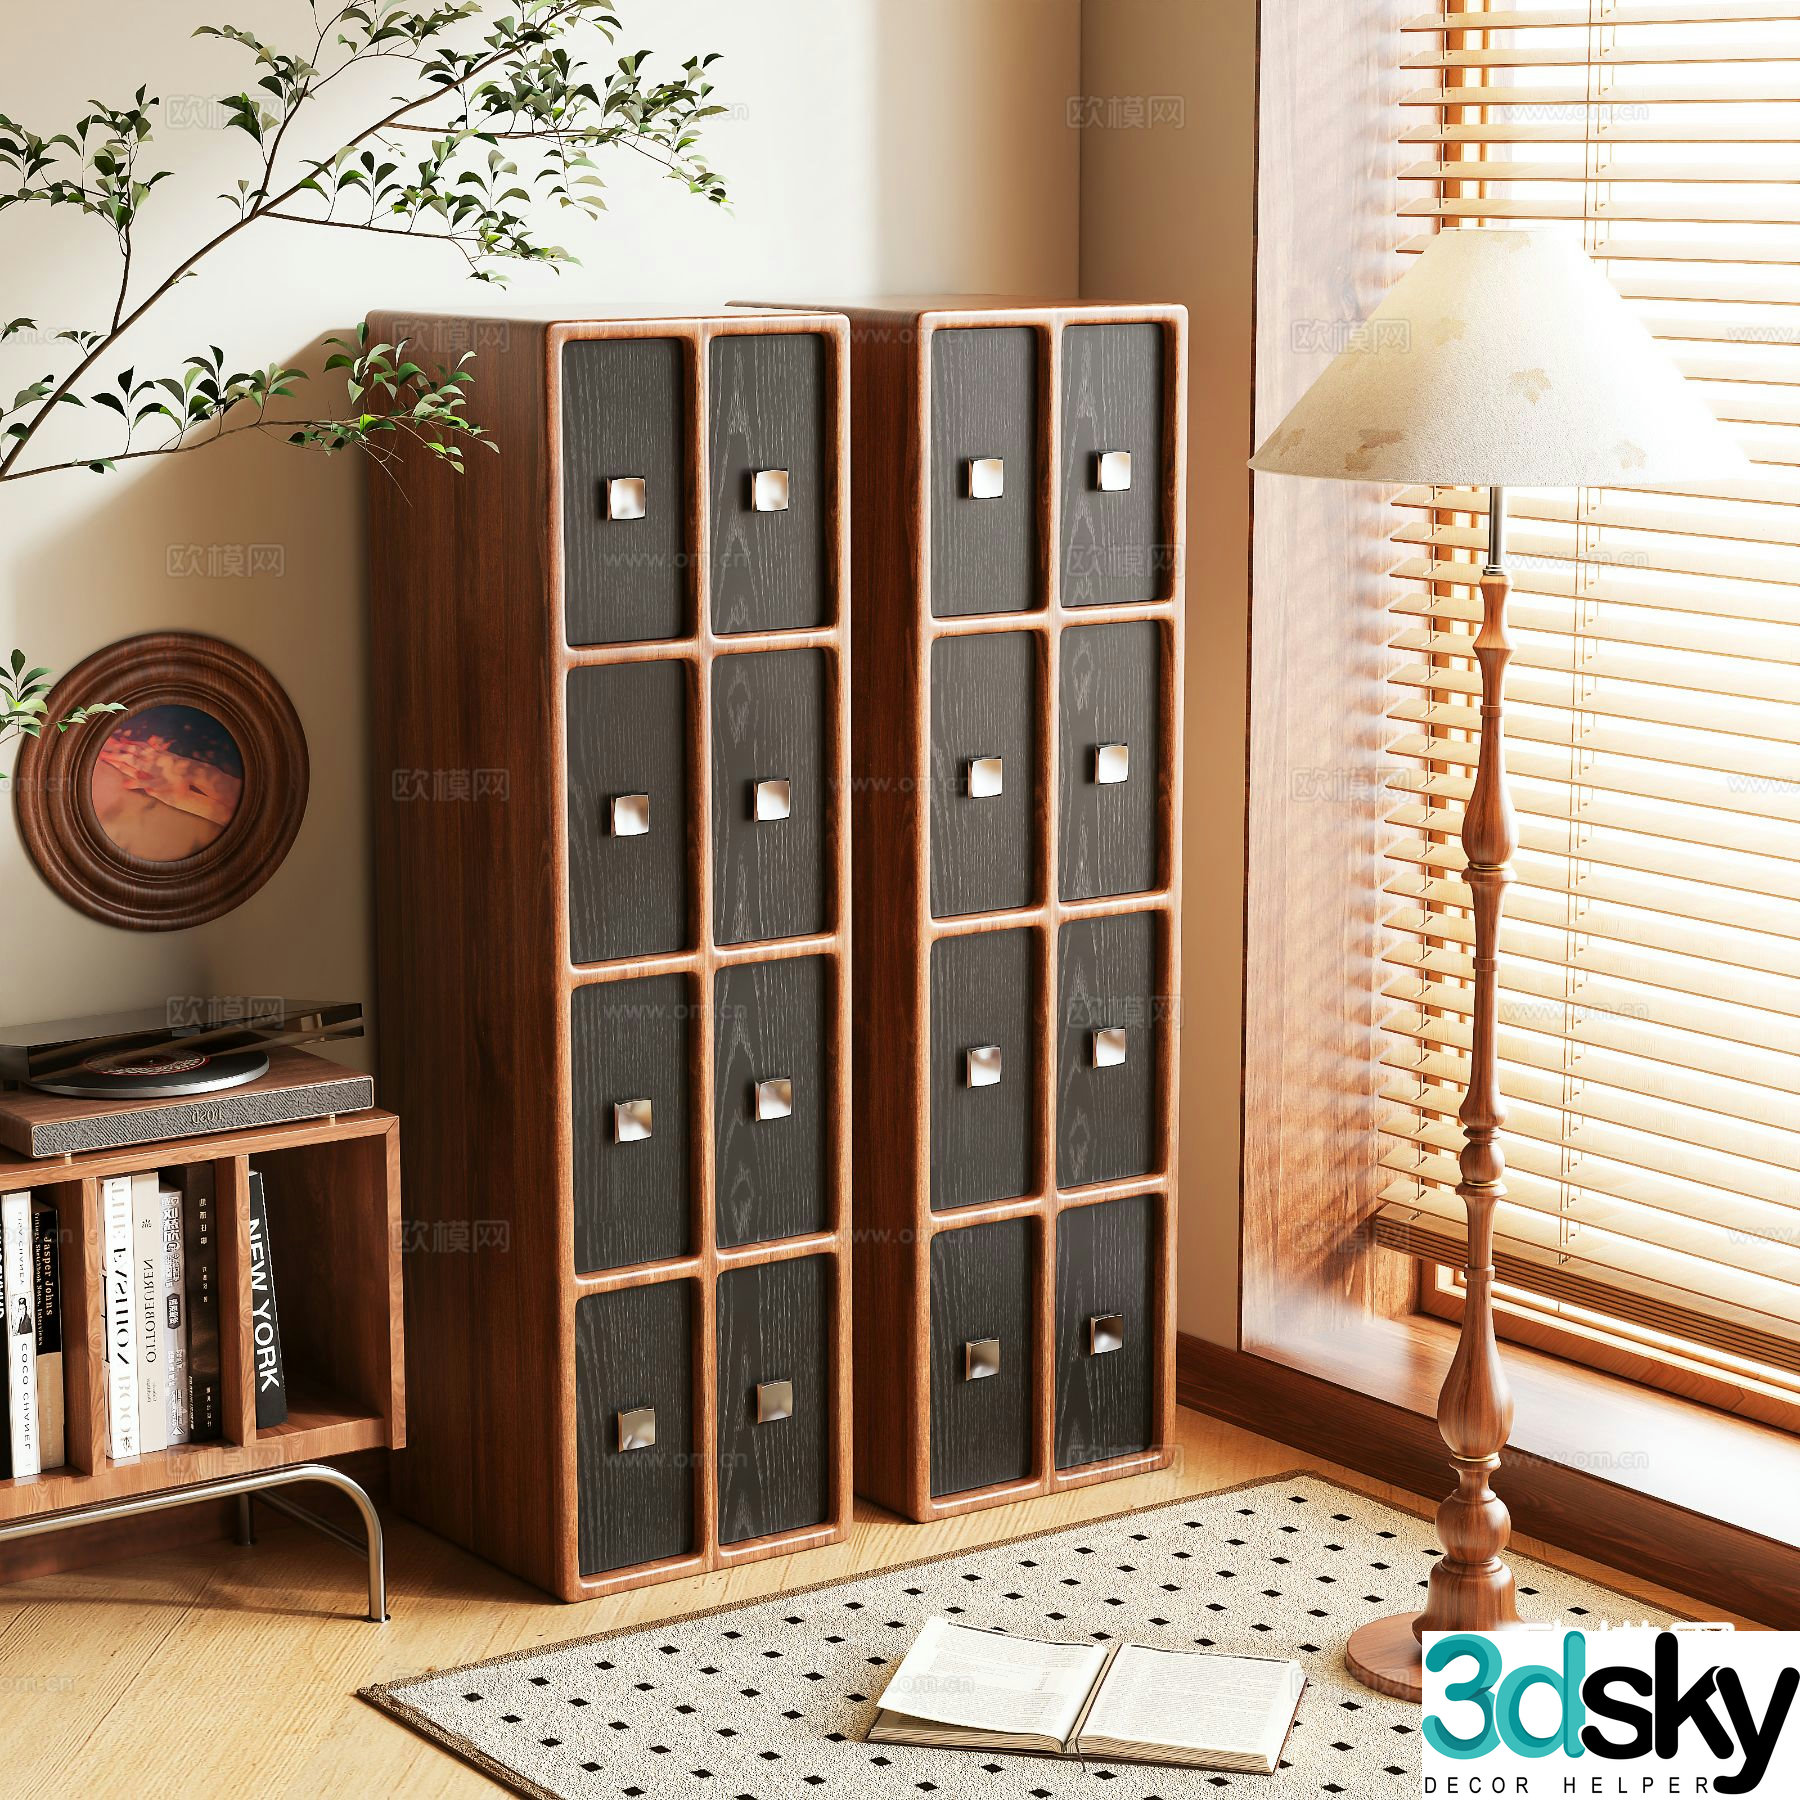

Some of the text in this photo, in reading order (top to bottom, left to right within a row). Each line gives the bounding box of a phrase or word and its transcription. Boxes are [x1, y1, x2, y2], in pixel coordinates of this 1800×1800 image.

[42, 1236, 54, 1316] Jasper Johns
[250, 1218, 281, 1393] NEW YORK
